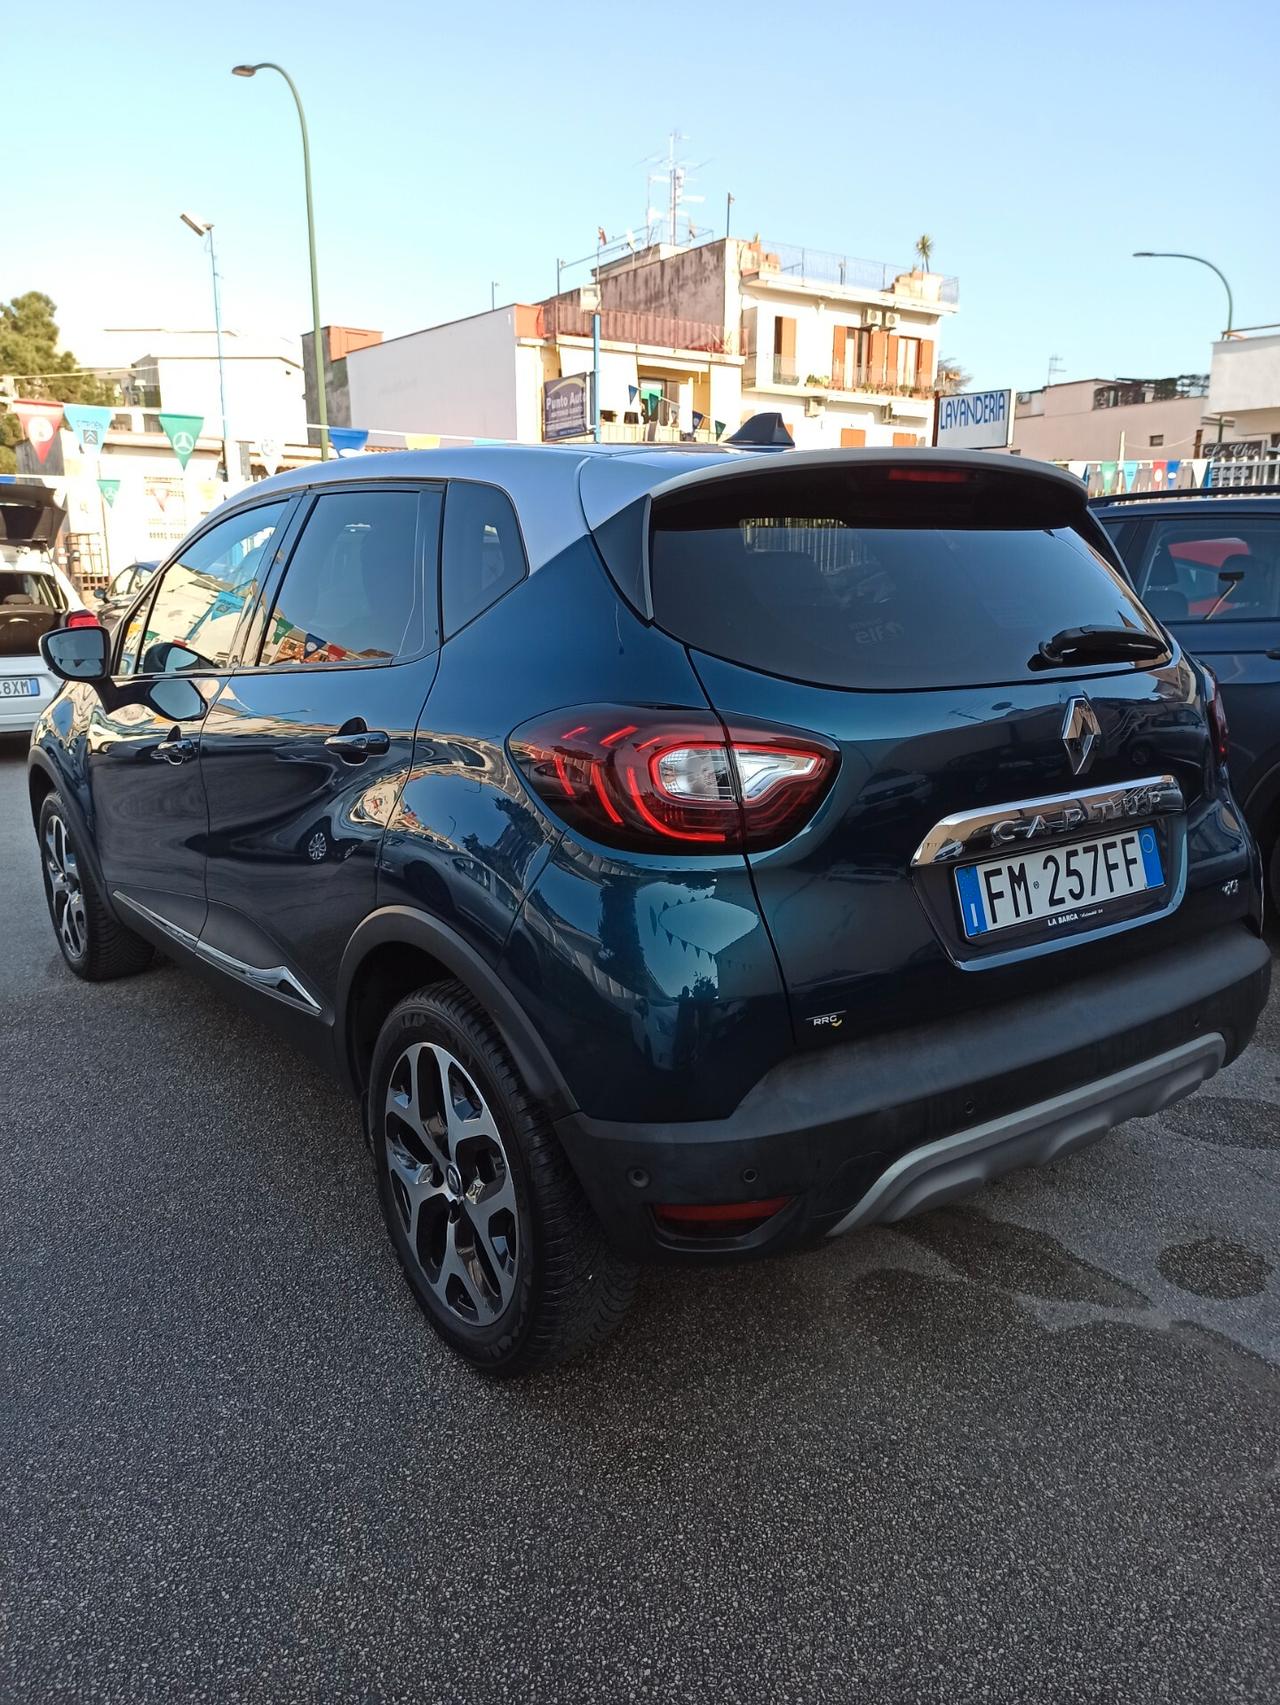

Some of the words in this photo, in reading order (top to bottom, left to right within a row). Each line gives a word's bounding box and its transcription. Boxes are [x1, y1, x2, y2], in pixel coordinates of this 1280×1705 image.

[546, 394, 568, 410] Punto
[940, 392, 1005, 430] LAVANDERIA
[1204, 444, 1227, 459] Le
[1229, 443, 1259, 457] Chic
[0, 681, 30, 695] 8XM
[984, 862, 1033, 924] FM
[1042, 836, 1138, 907] 257FF
[1047, 918, 1058, 926] LA
[1058, 913, 1079, 924] BARCA
